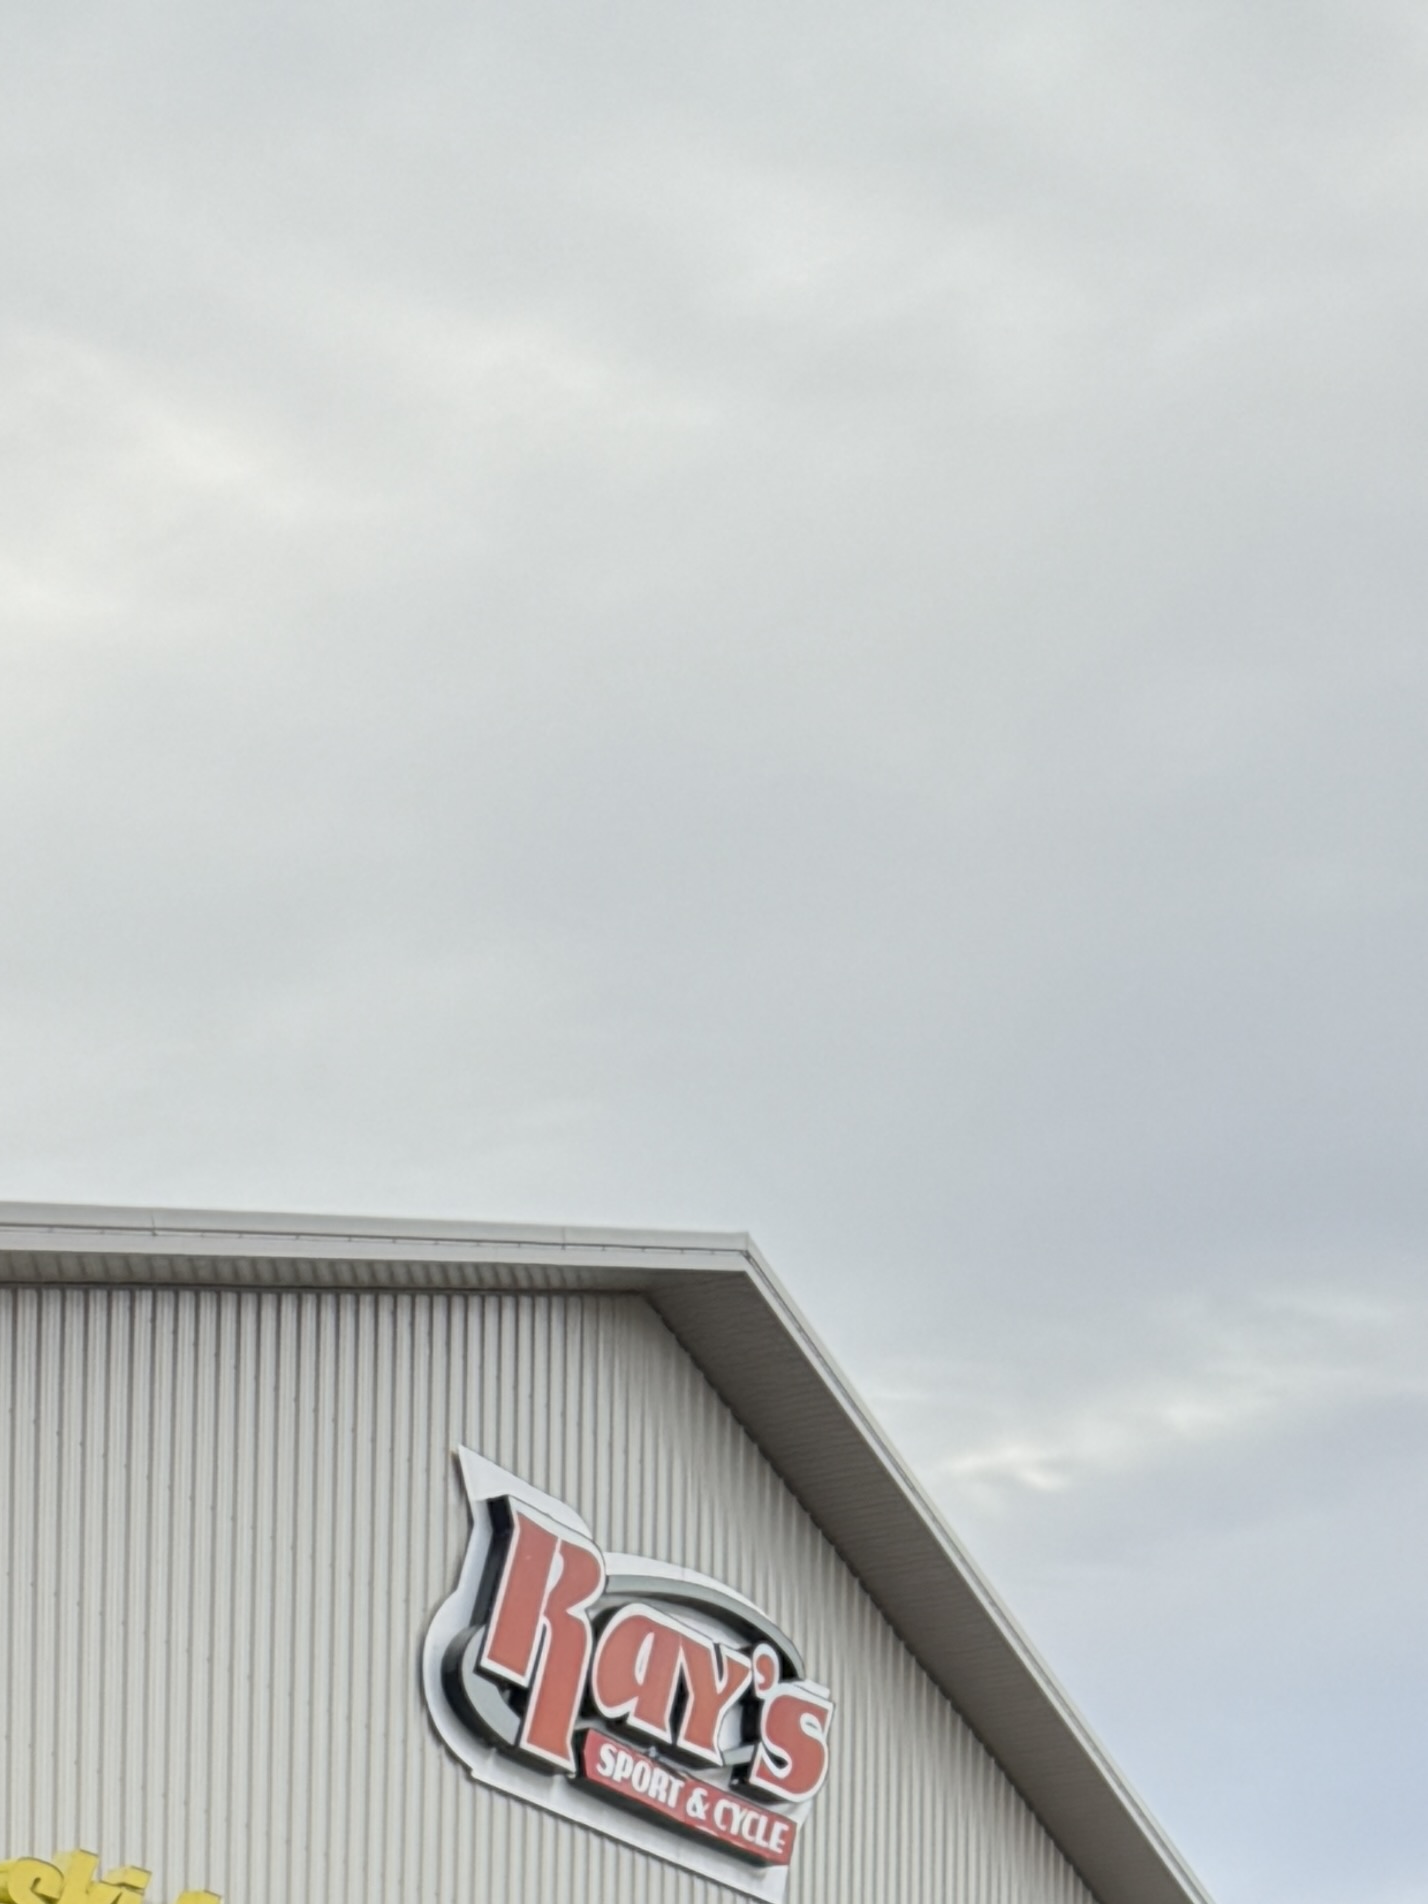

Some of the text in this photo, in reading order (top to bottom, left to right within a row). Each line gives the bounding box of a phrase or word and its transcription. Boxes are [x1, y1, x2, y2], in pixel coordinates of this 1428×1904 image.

[482, 1497, 835, 1803] Ray's
[598, 1743, 788, 1855] SPORT & CYCLE
